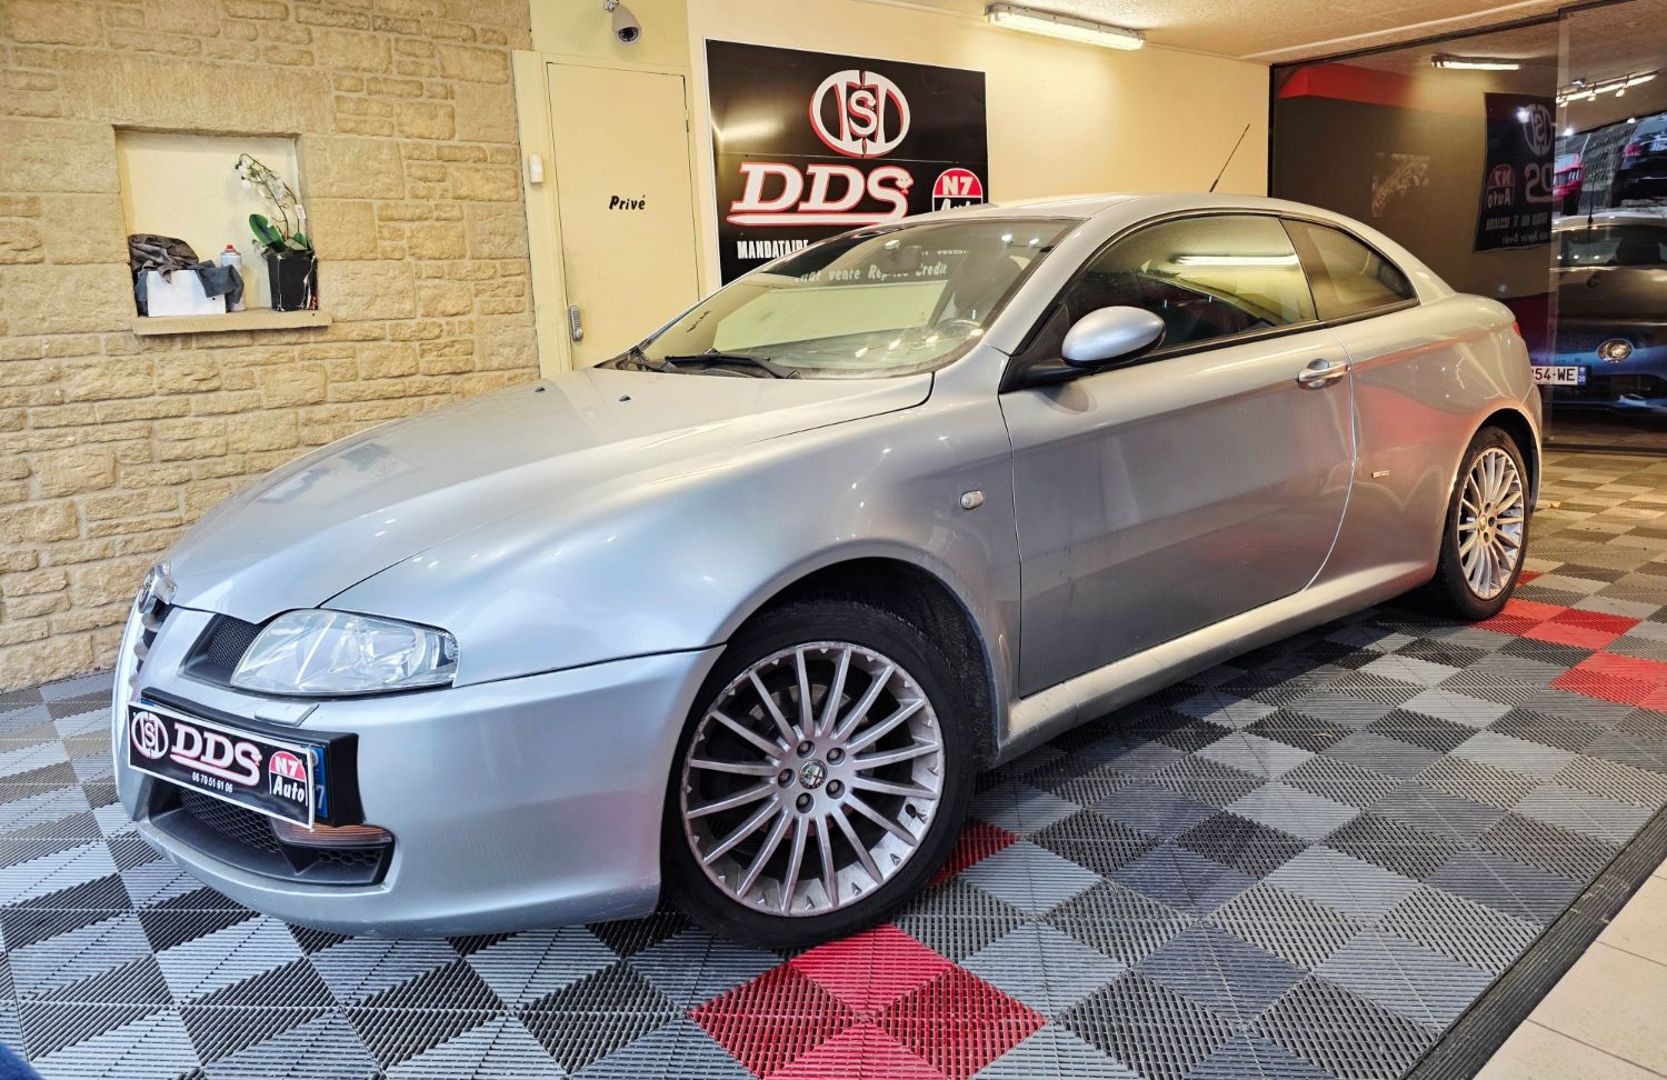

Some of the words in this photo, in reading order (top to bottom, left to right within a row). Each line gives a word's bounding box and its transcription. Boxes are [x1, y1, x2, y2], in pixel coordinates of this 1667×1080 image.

[727, 162, 914, 226] DDS
[942, 175, 974, 195] N7
[608, 194, 646, 210] Privé
[1532, 368, 1575, 381] 54-WE
[170, 722, 262, 787] DDS
[275, 756, 299, 778] N7
[273, 775, 305, 803] Auto
